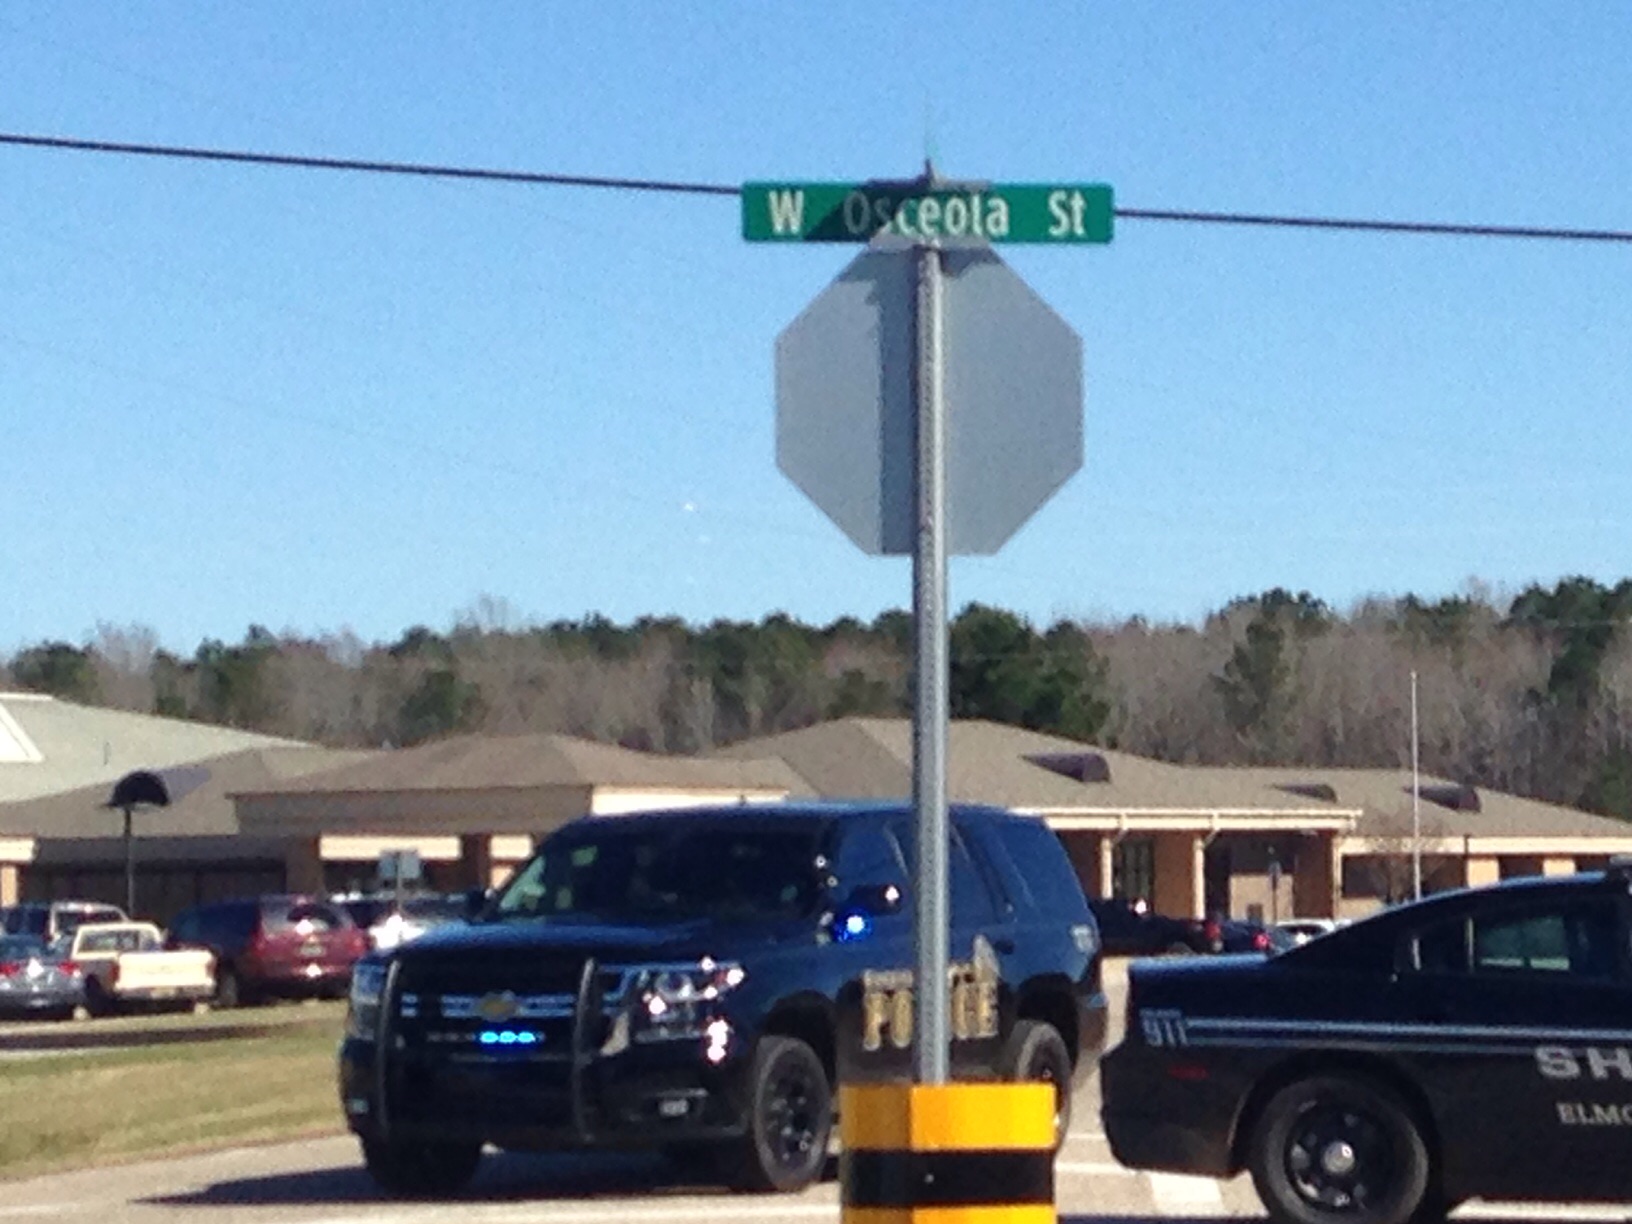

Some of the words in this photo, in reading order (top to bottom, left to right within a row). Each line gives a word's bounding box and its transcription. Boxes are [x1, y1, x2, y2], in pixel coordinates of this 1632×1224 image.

[768, 190, 804, 234] W
[845, 192, 1010, 238] Osceola
[1048, 190, 1086, 236] St
